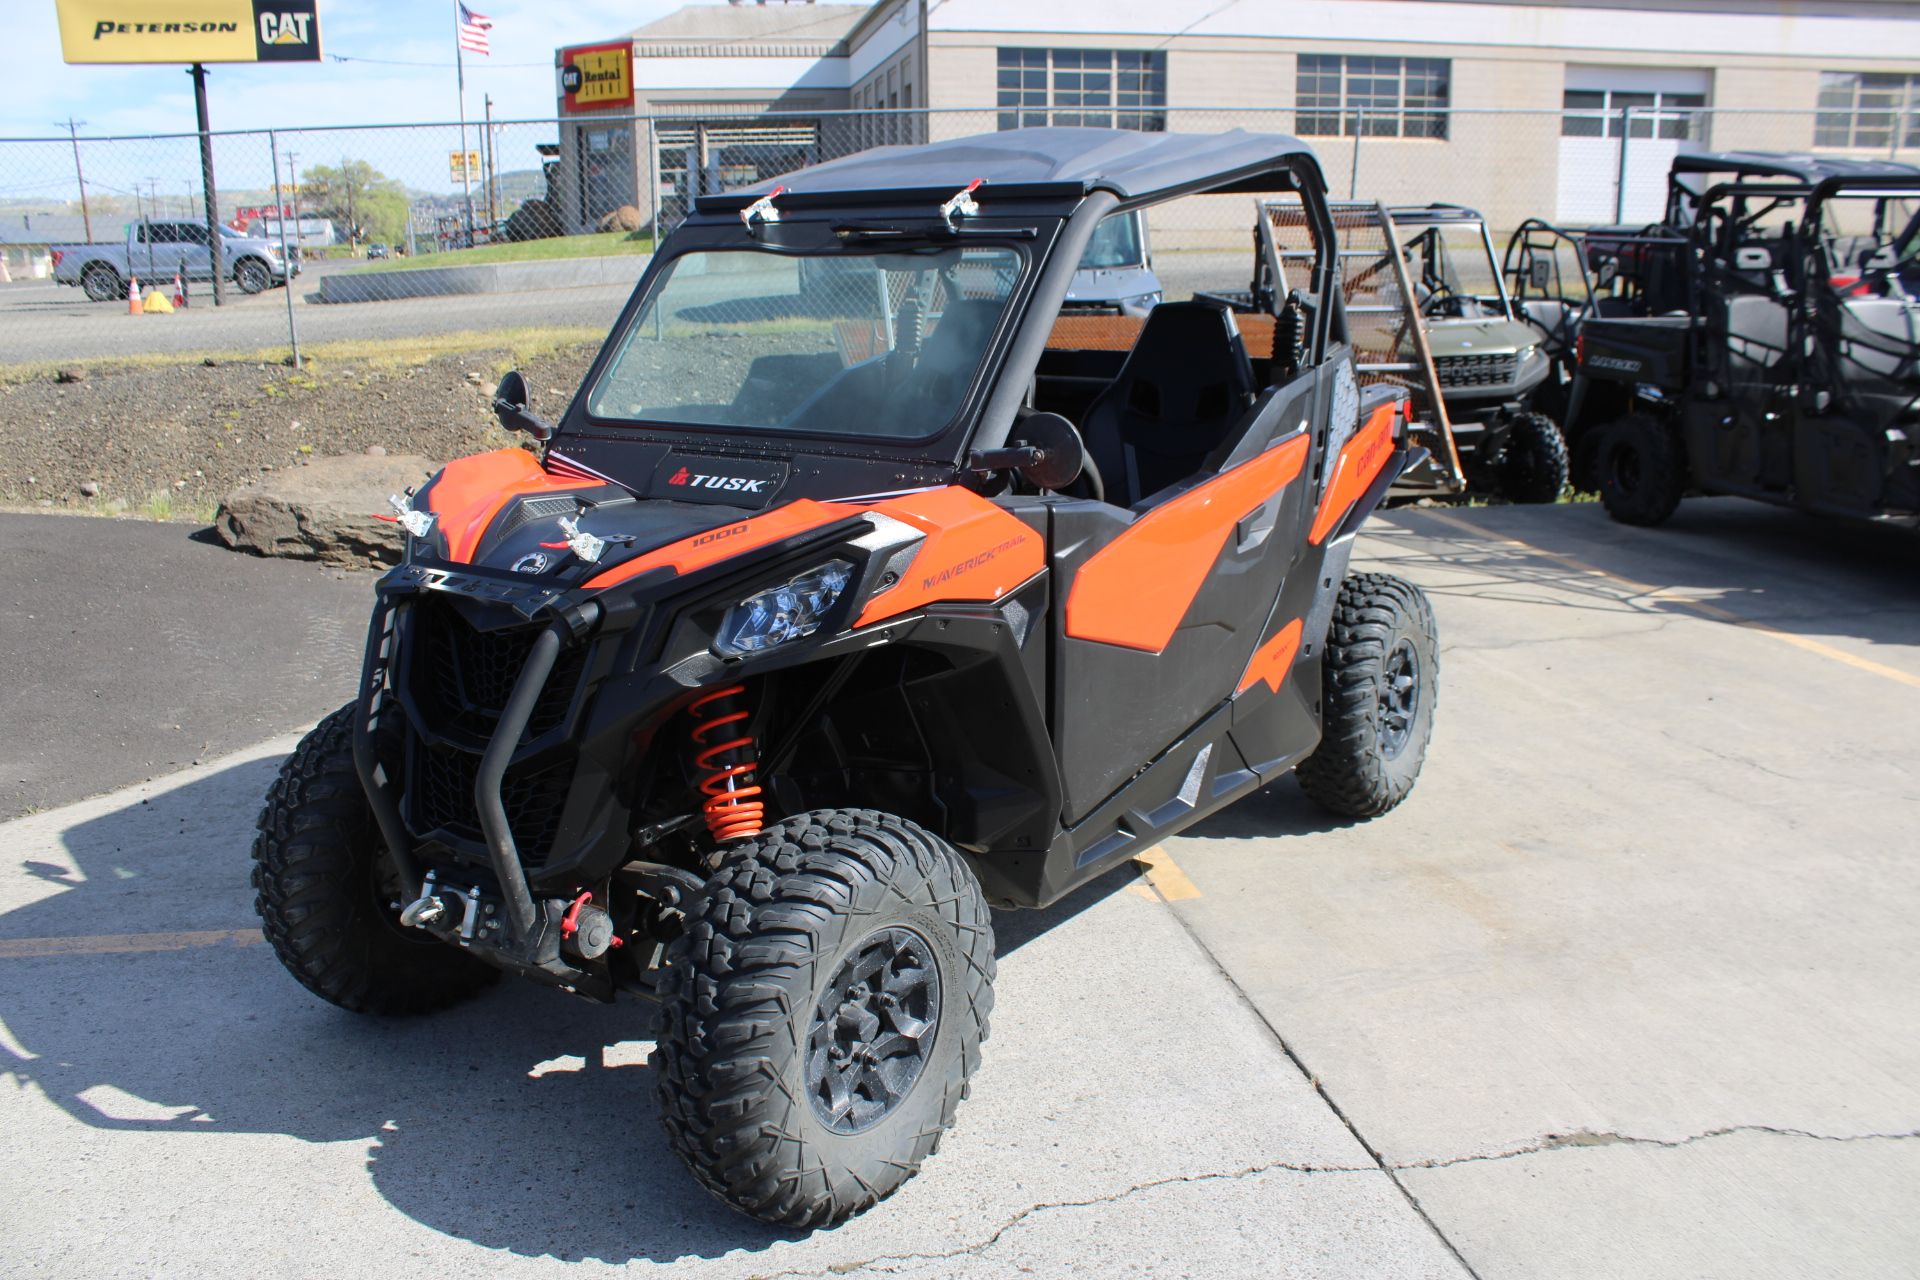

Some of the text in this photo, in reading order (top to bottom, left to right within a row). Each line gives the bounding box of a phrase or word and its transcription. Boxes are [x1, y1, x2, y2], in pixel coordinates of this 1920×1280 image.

[94, 21, 238, 40] PETERSON
[259, 11, 311, 45] CAT
[563, 71, 578, 86] CAT
[584, 68, 621, 83] Rental
[690, 474, 767, 493] TUSK
[693, 525, 748, 547] 1000
[923, 535, 1026, 591] MAVERICK TRAIL
